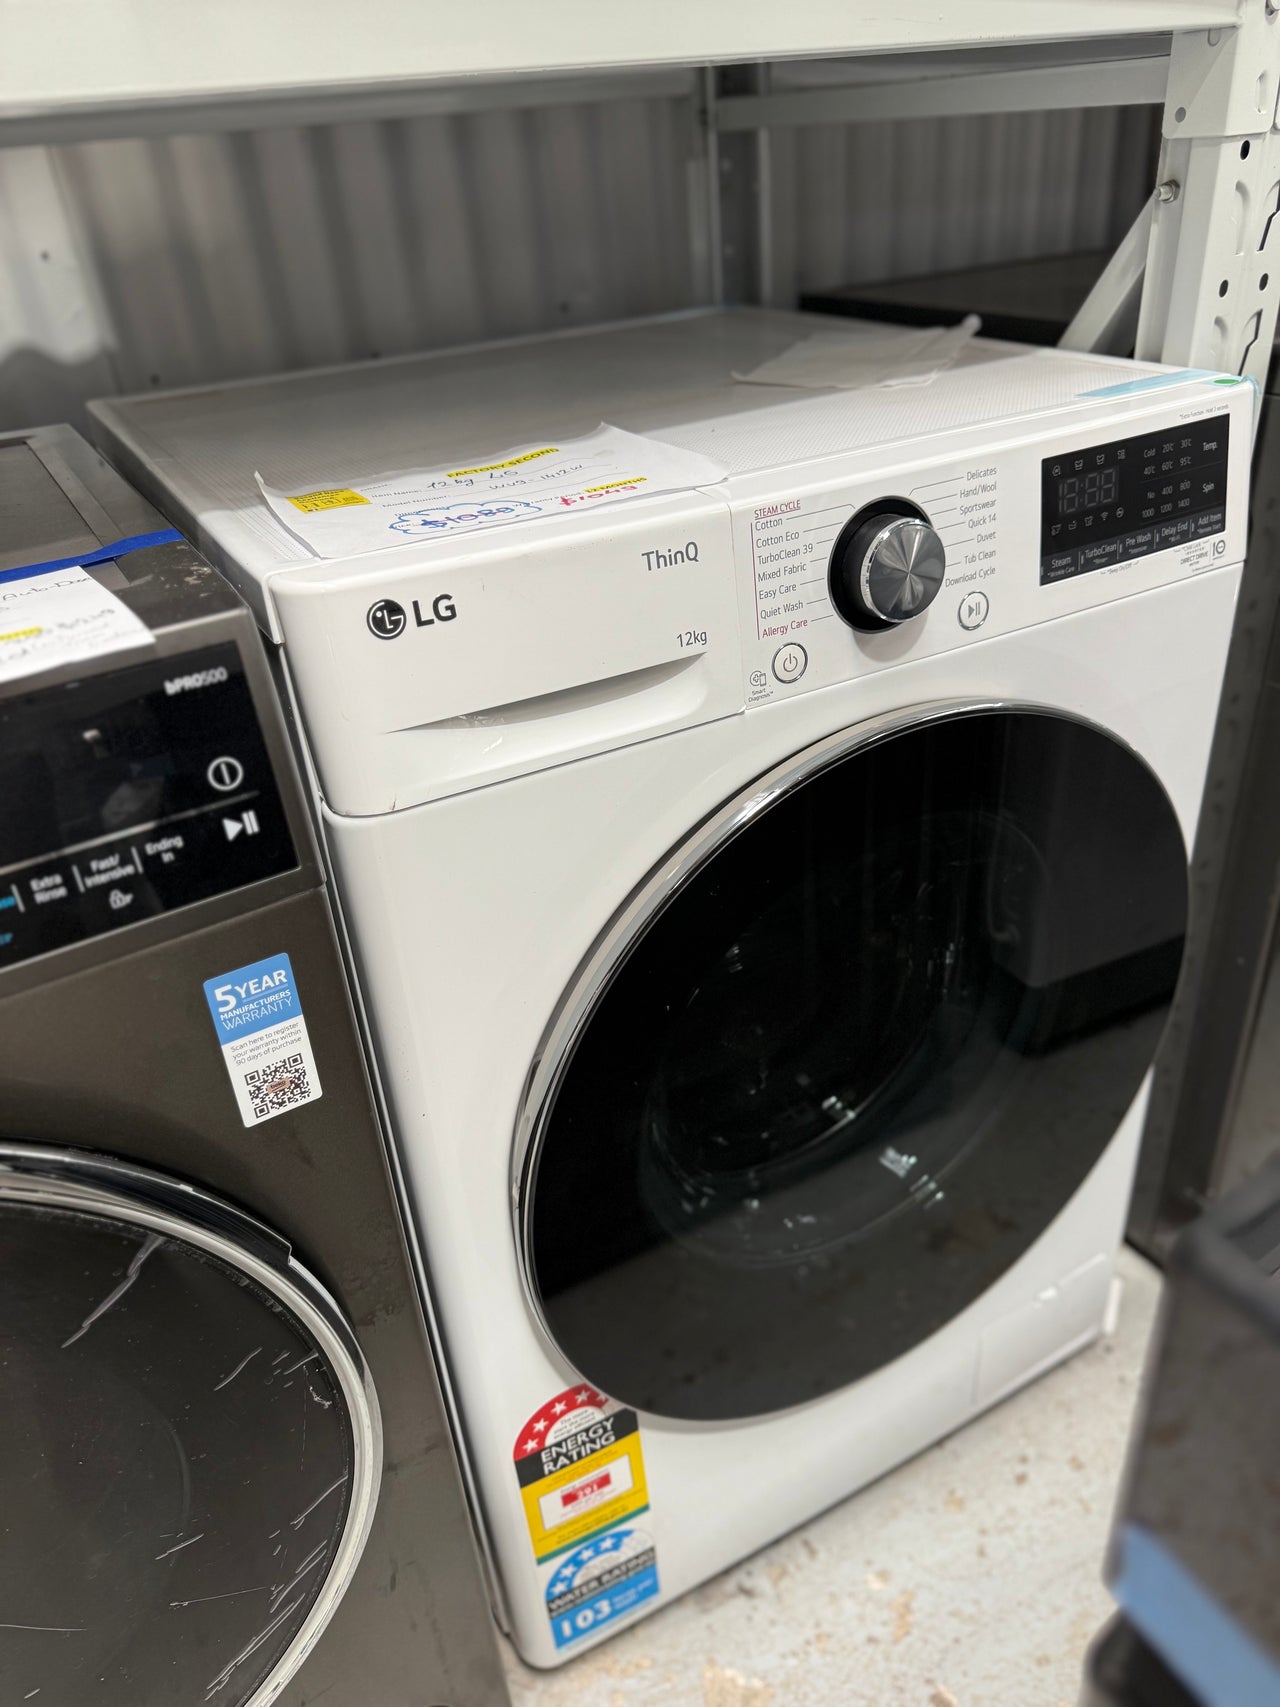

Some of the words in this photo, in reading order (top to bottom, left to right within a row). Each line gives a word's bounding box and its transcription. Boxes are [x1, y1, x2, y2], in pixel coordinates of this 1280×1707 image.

[447, 463, 506, 477] FACTORY
[509, 449, 560, 467] SECOND
[1143, 448, 1156, 458] Cold
[966, 466, 997, 482] Delicates
[959, 481, 997, 499] Hand/Wool
[1162, 486, 1173, 495] 400
[1202, 482, 1215, 494] Spin
[754, 507, 779, 518] STEAM
[779, 500, 801, 513] CYCLE
[959, 500, 997, 516] Sportswear
[754, 518, 783, 532] Cotton
[968, 517, 986, 529] Quick
[988, 513, 997, 523] 14
[756, 535, 784, 549] Cotton
[785, 530, 800, 541] Eco
[976, 532, 997, 543] Duvet
[1051, 557, 1071, 569] Steam
[1084, 543, 1117, 559] TurboClean
[1161, 526, 1176, 538] Delay
[1177, 521, 1188, 532] End
[1198, 516, 1209, 525] Add
[642, 541, 699, 571] ThinQ
[757, 549, 801, 565] TurboClean
[802, 543, 814, 554] 39
[964, 555, 977, 565] Tub
[977, 550, 997, 561] Clean
[757, 571, 782, 583] Mixed
[783, 563, 807, 576] Fabric
[945, 573, 976, 588] Download
[978, 566, 996, 579] Cycle
[759, 588, 777, 601] Easy
[778, 584, 797, 595] Care
[412, 593, 458, 628] LG
[760, 607, 782, 620] Quiet
[783, 600, 804, 613] Wash
[762, 625, 789, 640] Allergy
[790, 618, 808, 630] Care
[676, 630, 708, 649] 12kg
[164, 667, 228, 696] bPRO500
[145, 835, 184, 855] Ending
[90, 853, 121, 872] Fast/
[161, 851, 175, 863] In
[30, 874, 63, 891] Extra
[84, 864, 135, 888] Intensive
[34, 886, 68, 905] Rinse
[214, 984, 238, 1013] 5
[234, 969, 288, 999] YEAR
[220, 989, 291, 1021] MANUFACTURERS
[222, 996, 294, 1031] WARRANTY
[230, 1042, 248, 1052] Scan
[249, 1036, 264, 1046] here
[265, 1031, 272, 1039] to
[273, 1022, 299, 1036] register
[233, 1050, 248, 1061] your
[249, 1038, 279, 1053] warranty
[280, 1029, 302, 1041] within
[247, 1053, 262, 1062] days
[263, 1047, 271, 1055] of
[272, 1037, 302, 1053] purchase
[540, 1417, 615, 1463] ENERGY
[543, 1431, 616, 1476] RATING
[561, 1599, 612, 1638] 103
